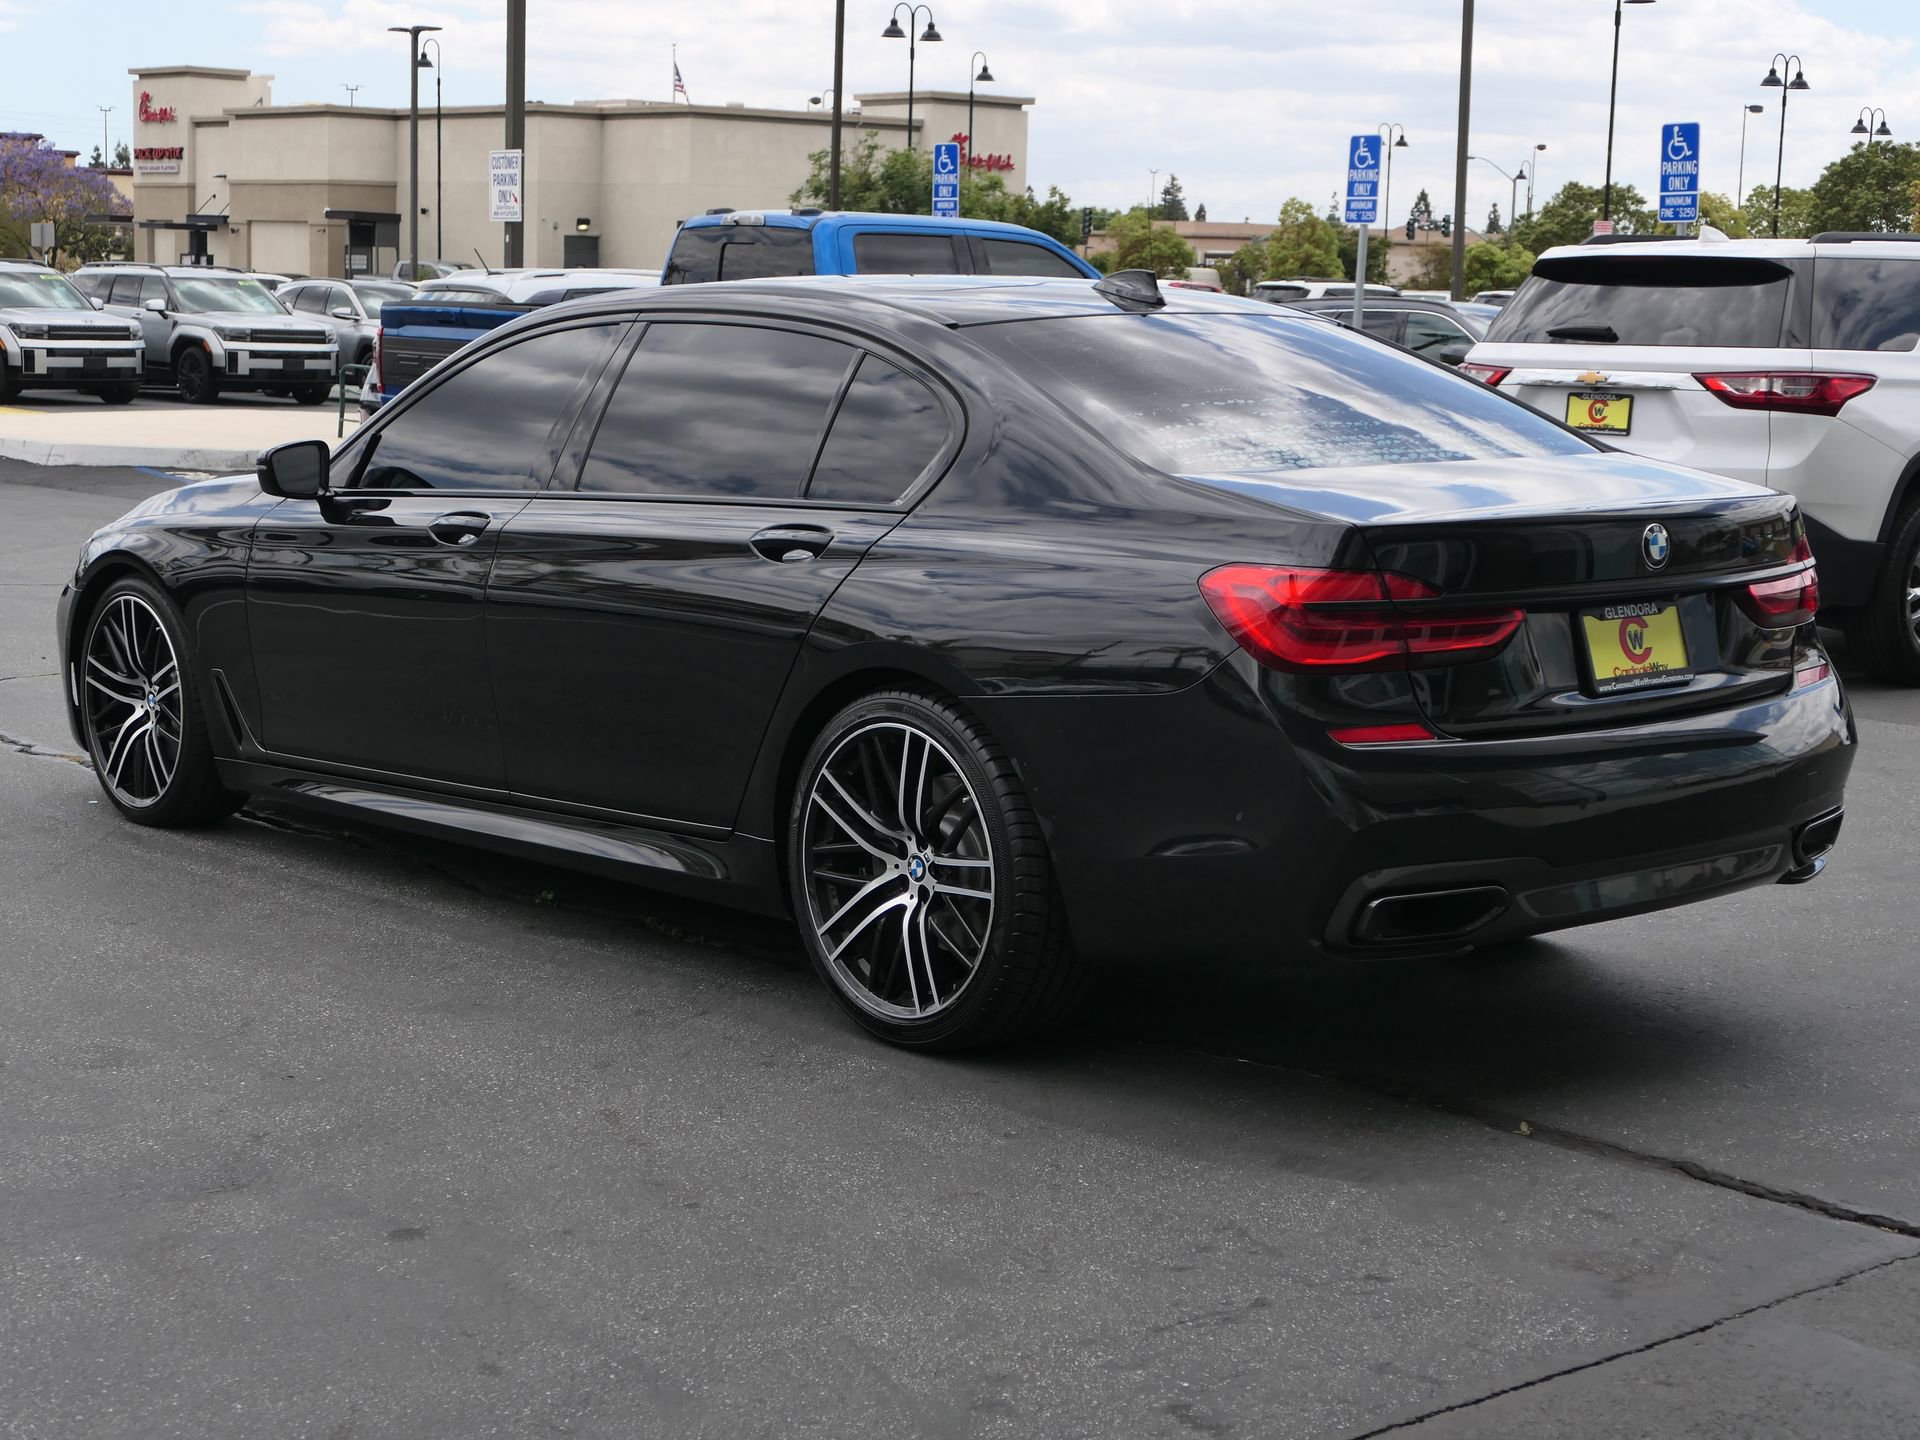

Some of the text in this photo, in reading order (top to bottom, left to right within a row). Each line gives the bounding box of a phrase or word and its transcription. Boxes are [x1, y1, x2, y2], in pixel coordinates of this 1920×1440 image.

[492, 155, 519, 169] CUSTOMER
[1662, 160, 1697, 175] PARKING
[493, 173, 517, 186] PARKING
[934, 173, 957, 184] PARKING
[1349, 168, 1378, 182] PARKING
[1354, 183, 1372, 196] ONLY
[1668, 176, 1690, 191] ONLY
[498, 190, 512, 203] ONLY
[939, 186, 952, 197] ONLY
[1665, 196, 1692, 206] MINIMUM
[1661, 208, 1675, 218] FINE
[1604, 602, 1659, 619] GLENDORA
